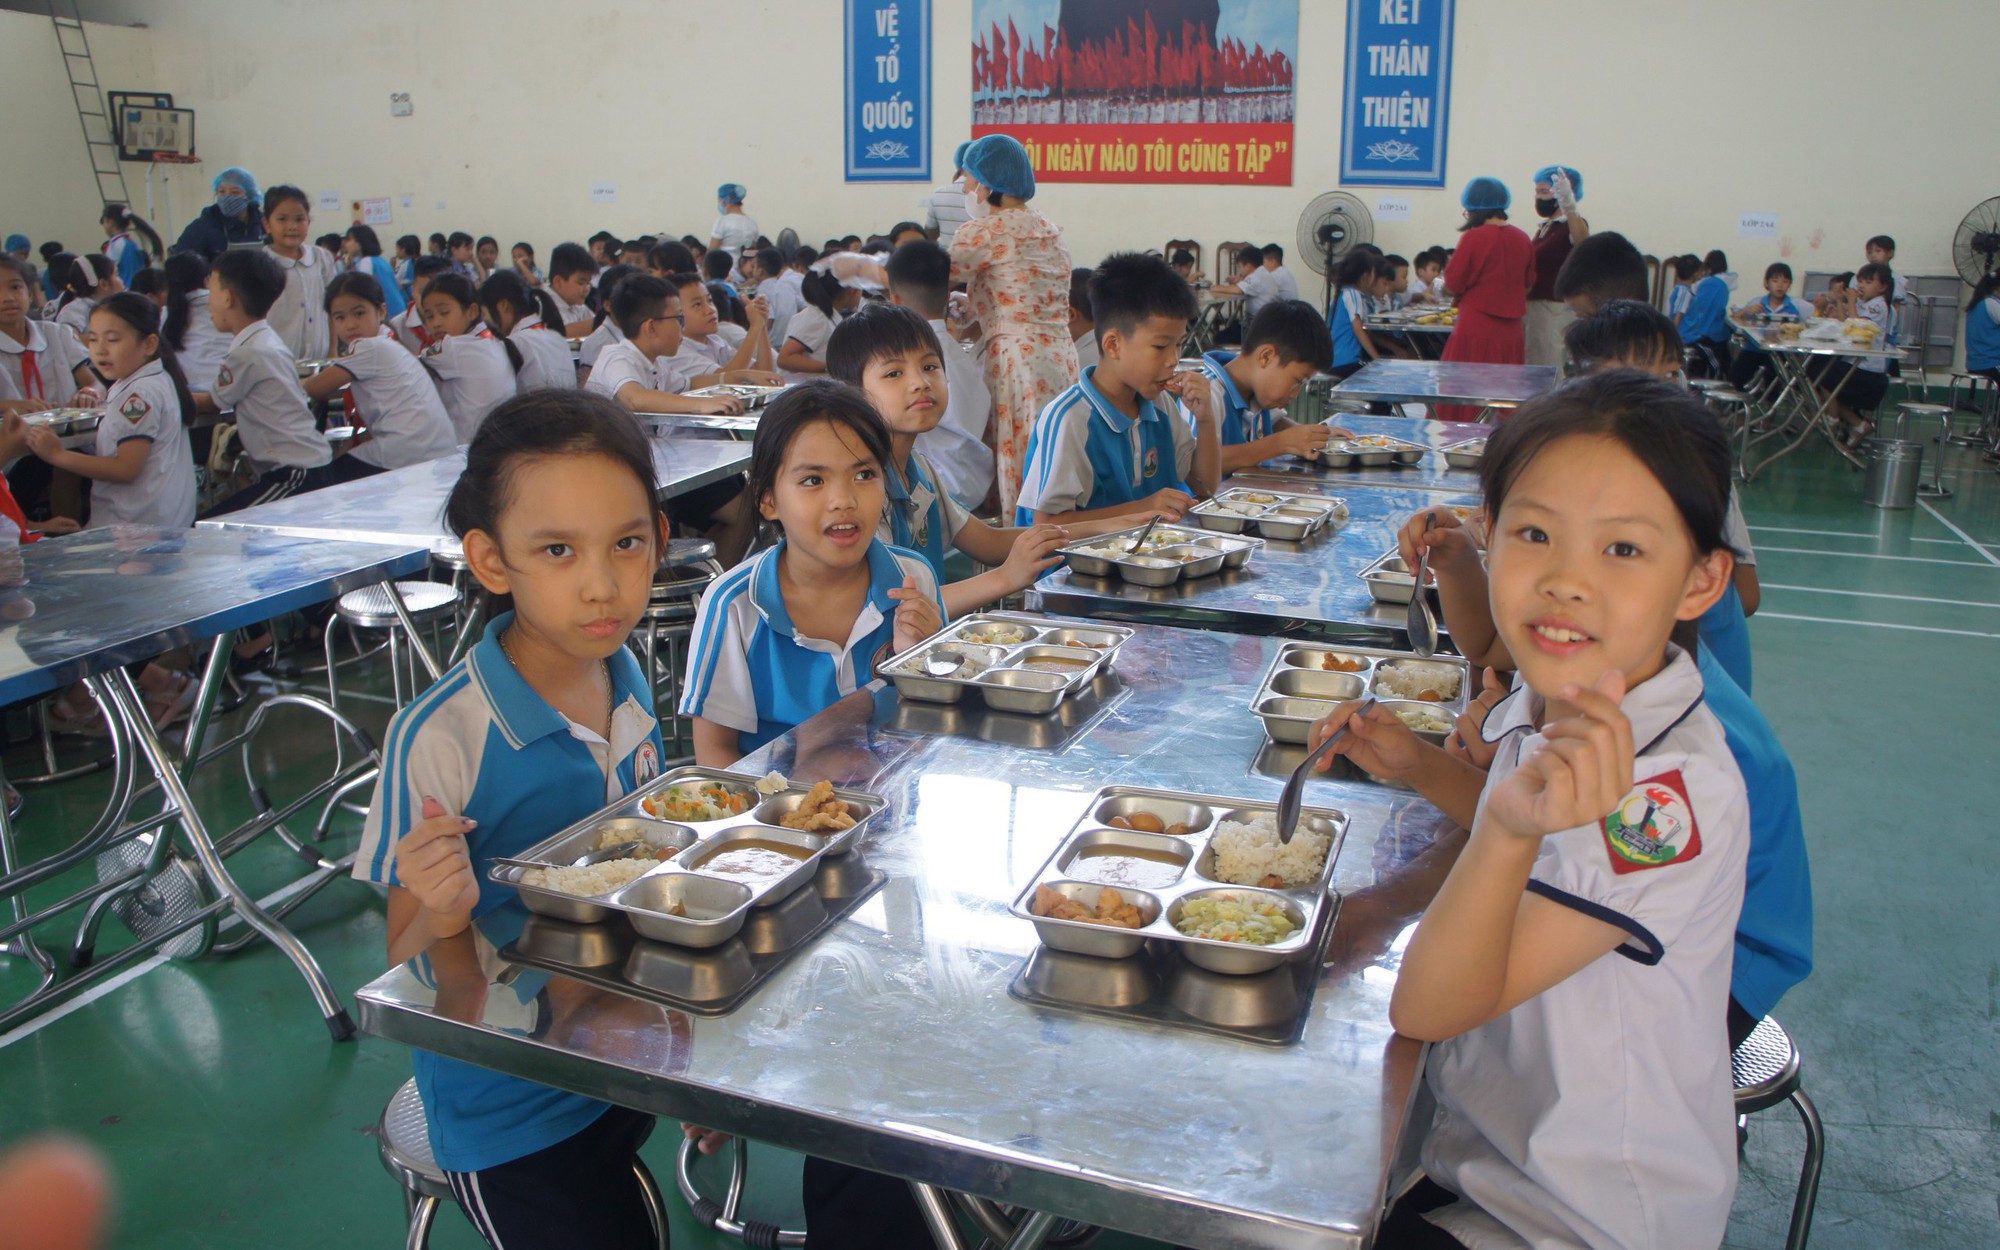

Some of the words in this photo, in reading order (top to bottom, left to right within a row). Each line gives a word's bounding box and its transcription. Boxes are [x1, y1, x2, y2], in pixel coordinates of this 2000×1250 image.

[875, 3, 899, 43] VỆ
[875, 44, 900, 83] TỔ
[1367, 38, 1429, 76] THÂN
[862, 91, 914, 133] QUỐC
[1362, 90, 1430, 135] THIỆN
[1025, 138, 1042, 171] ÔI
[1046, 138, 1095, 172] NGÀY
[1100, 138, 1138, 172] NÀO
[1143, 137, 1173, 172] TÔI
[1177, 137, 1230, 173] CŨNG
